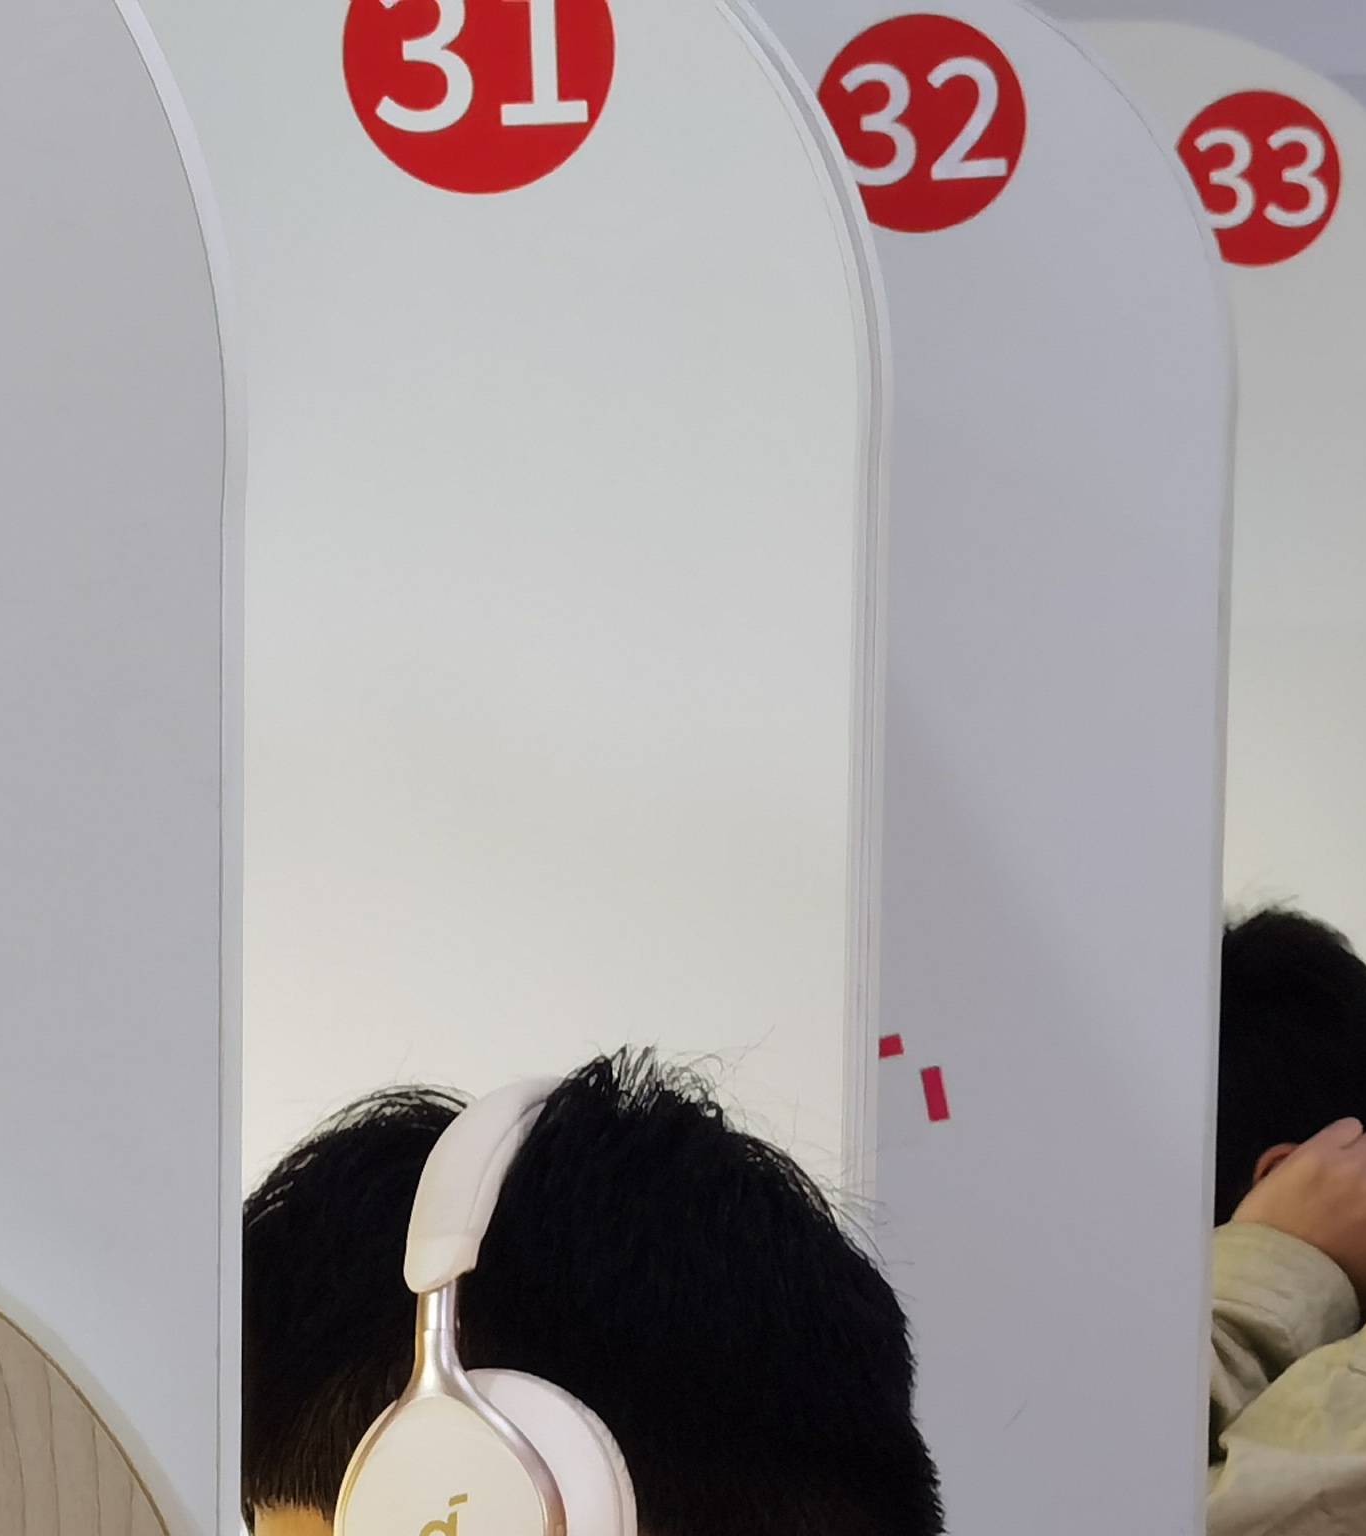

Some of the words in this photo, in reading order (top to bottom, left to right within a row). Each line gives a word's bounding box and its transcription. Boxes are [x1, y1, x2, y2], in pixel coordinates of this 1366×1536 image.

[375, 0, 589, 133] 31
[838, 57, 1008, 187] 32
[1193, 126, 1329, 230] 33
